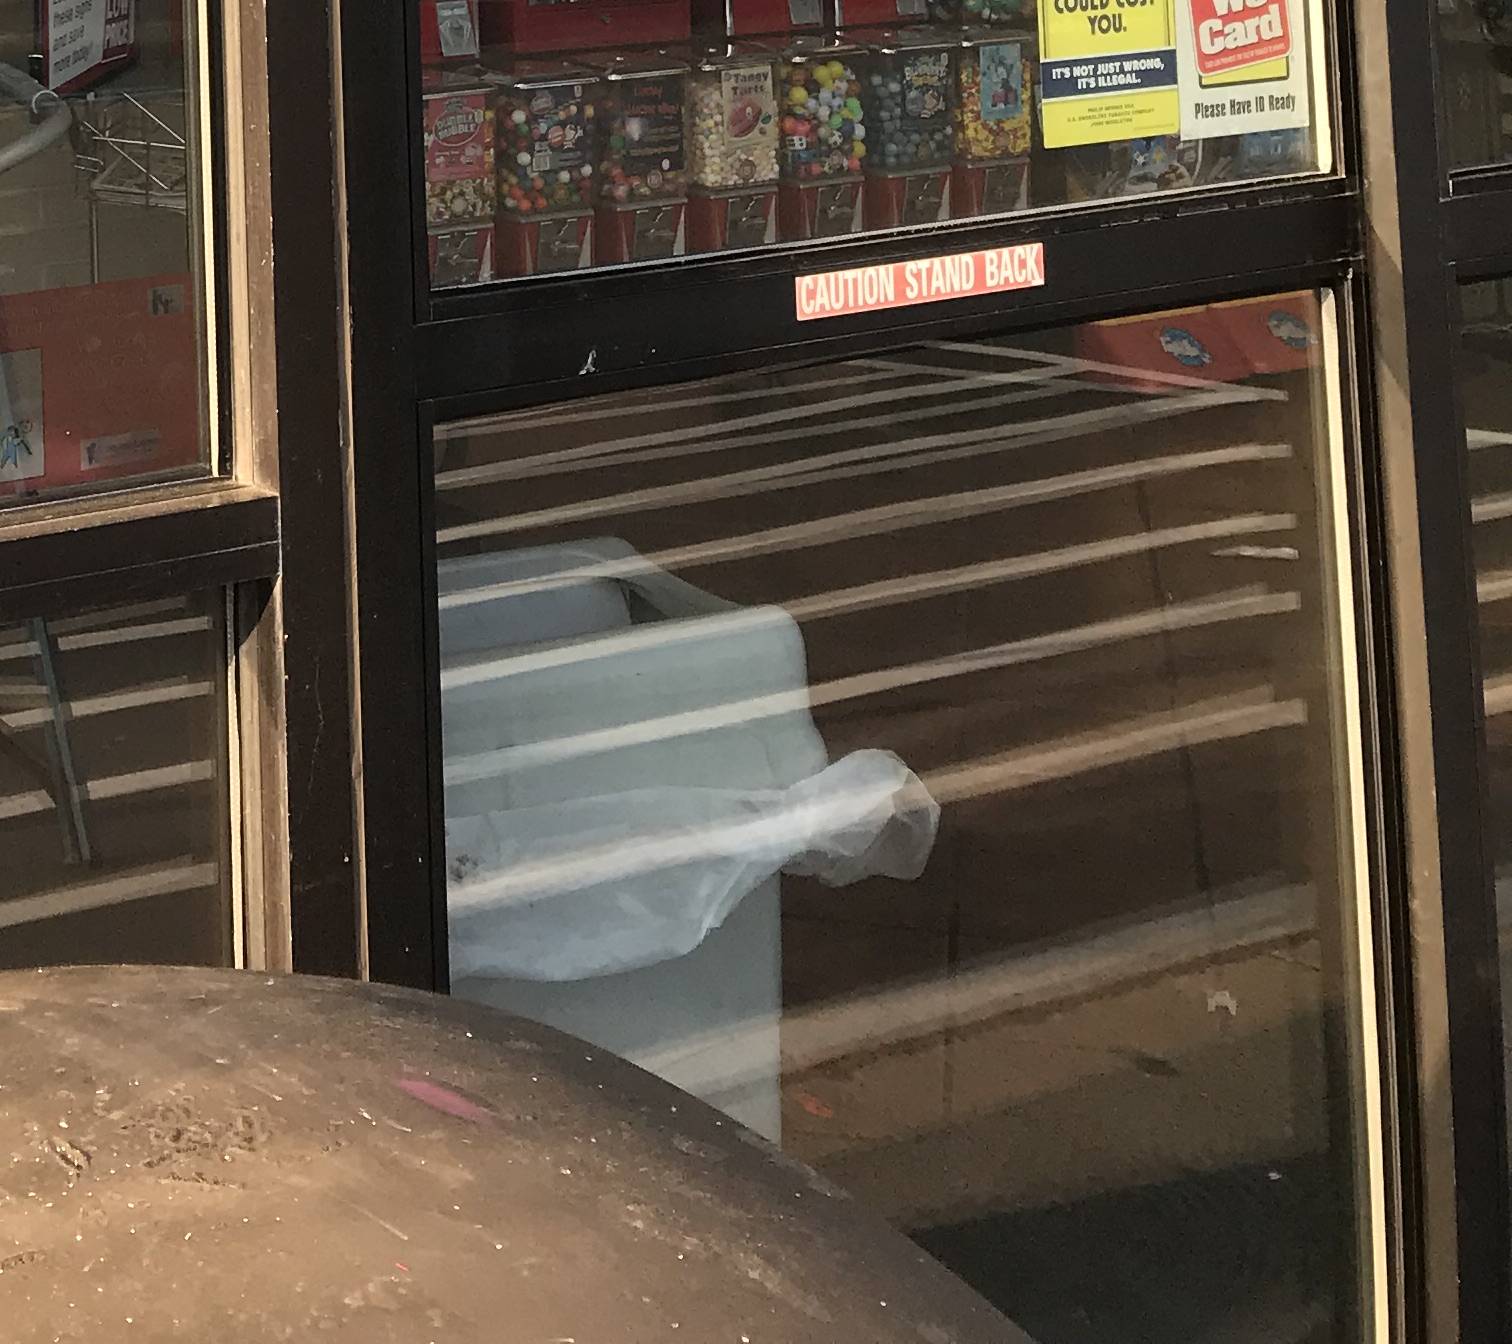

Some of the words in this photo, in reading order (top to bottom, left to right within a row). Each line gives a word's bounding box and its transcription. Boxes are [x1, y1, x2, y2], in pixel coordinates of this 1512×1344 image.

[1086, 13, 1128, 36] YOU.
[1198, 3, 1285, 55] Card
[1051, 67, 1071, 80] IT'S
[1072, 64, 1095, 78] NOT
[1096, 61, 1121, 75] JUST
[1122, 57, 1165, 72] WRONG,
[1077, 77, 1097, 90] IT'S
[1098, 72, 1142, 88] ILLEGAL.
[1194, 102, 1227, 120] Please
[1229, 97, 1252, 116] Have
[1255, 95, 1265, 113] ID
[1268, 92, 1296, 112] Ready
[801, 263, 896, 315] CAUTION
[904, 252, 976, 300] STAND
[985, 243, 1041, 288] BACK
